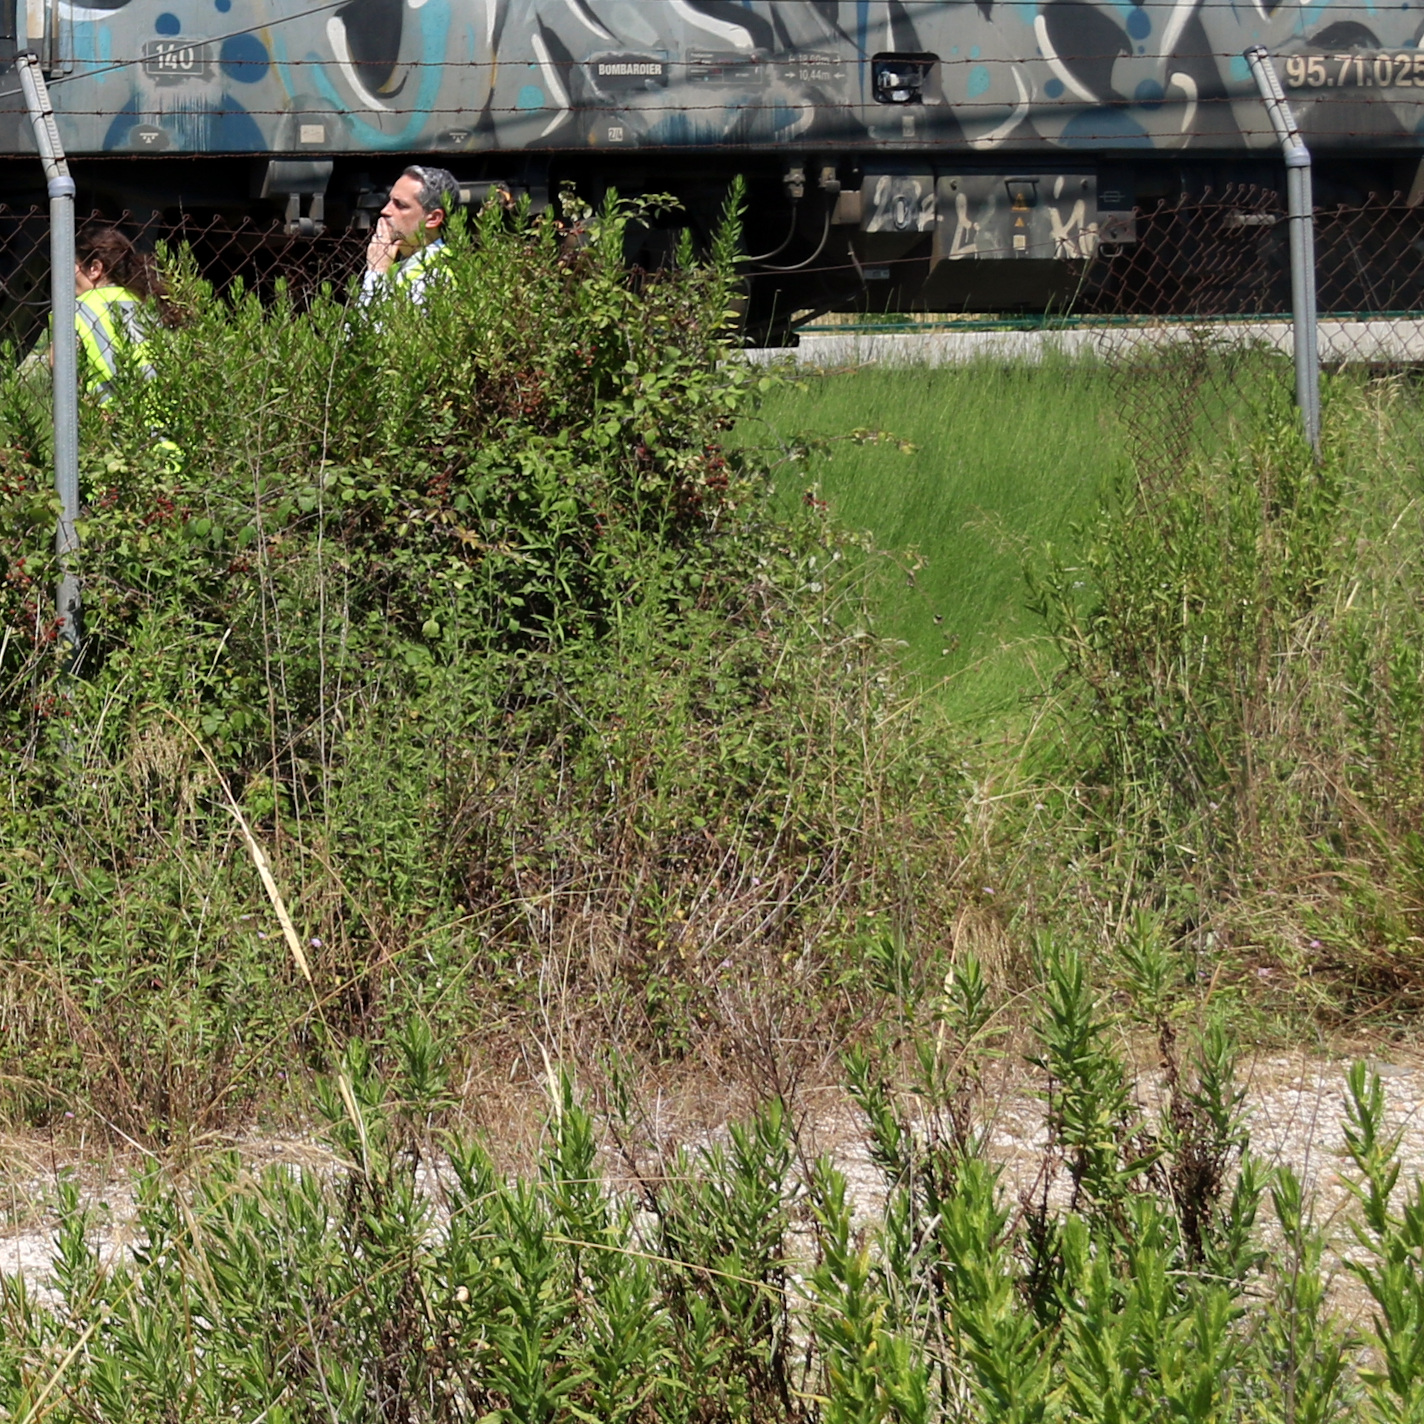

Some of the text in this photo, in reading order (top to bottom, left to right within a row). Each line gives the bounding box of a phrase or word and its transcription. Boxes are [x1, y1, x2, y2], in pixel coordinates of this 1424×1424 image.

[156, 43, 194, 70] 140
[598, 63, 662, 75] BOMBARDIER
[798, 69, 830, 82] 10,44m
